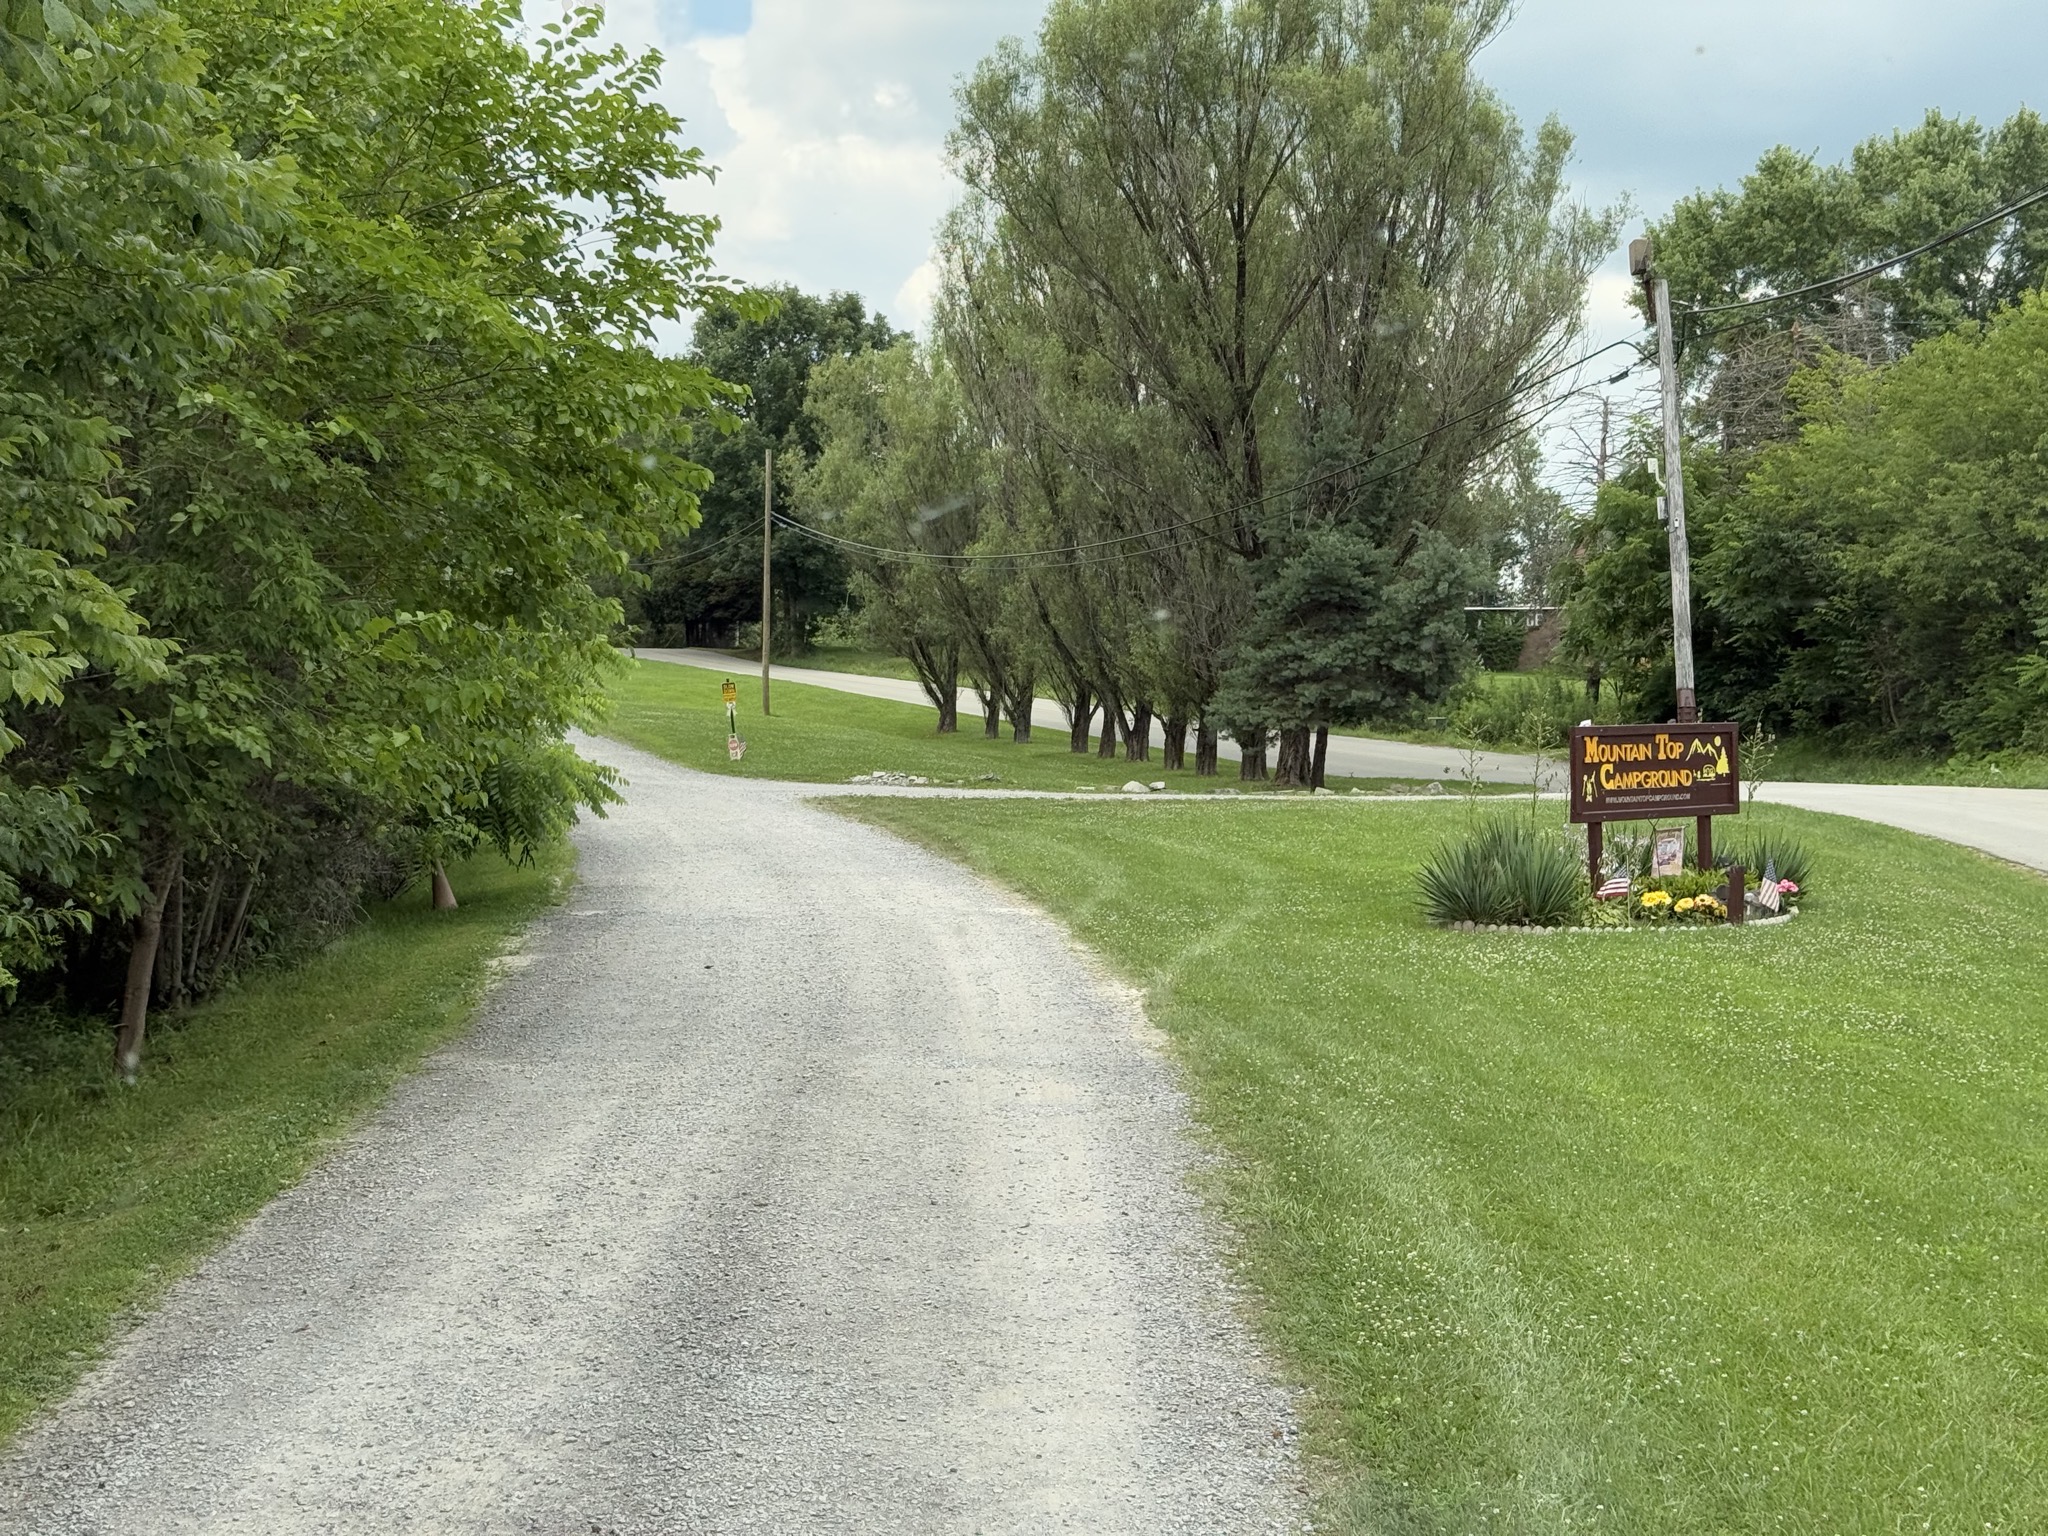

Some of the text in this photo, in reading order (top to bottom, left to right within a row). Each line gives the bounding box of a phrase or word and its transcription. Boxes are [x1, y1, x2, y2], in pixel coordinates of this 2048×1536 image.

[1584, 734, 1684, 763] MOUNTAIN TOP
[1600, 763, 1693, 790] CAMPGROUND
